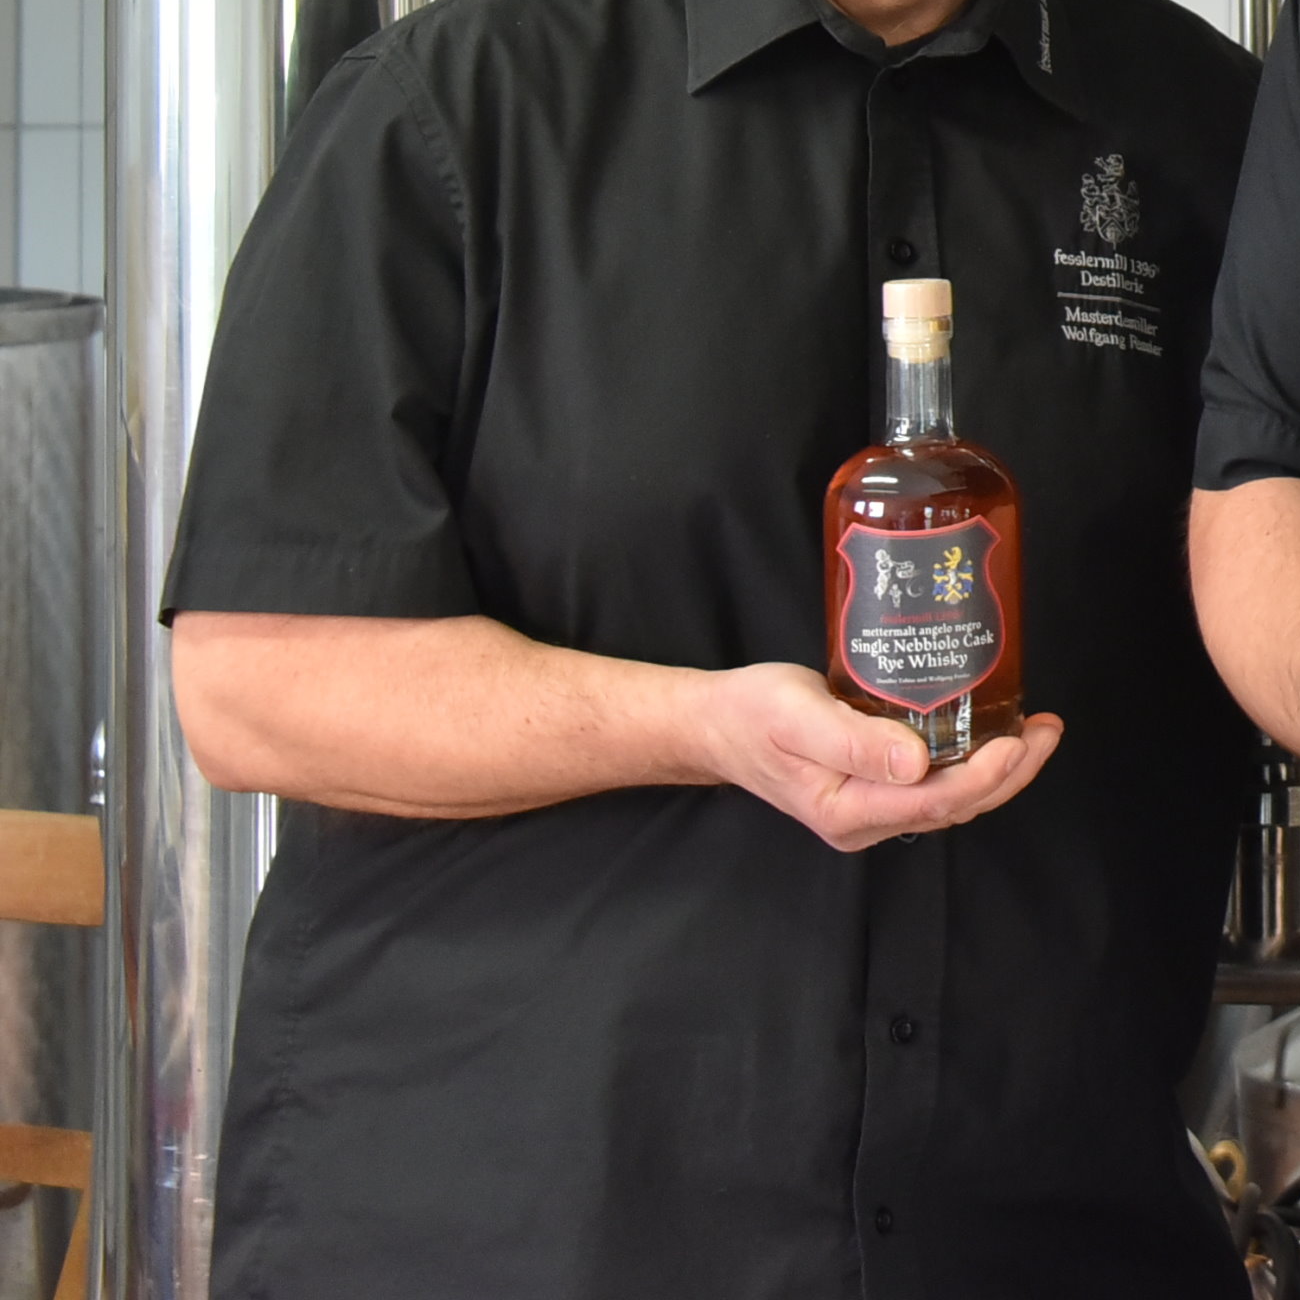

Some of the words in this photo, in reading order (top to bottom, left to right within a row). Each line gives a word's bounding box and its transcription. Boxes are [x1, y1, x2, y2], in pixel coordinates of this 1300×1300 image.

[1054, 248, 1128, 272] fesslermill
[1061, 325, 1126, 350] Wolfgang
[862, 625, 916, 638] mettermalt
[918, 623, 953, 641] angelo
[955, 620, 982, 636] negro
[851, 638, 890, 657] Single
[893, 633, 960, 654] Nebbiolo
[962, 630, 994, 648] Cask
[877, 655, 905, 674] Rye
[908, 651, 968, 670] Whisky
